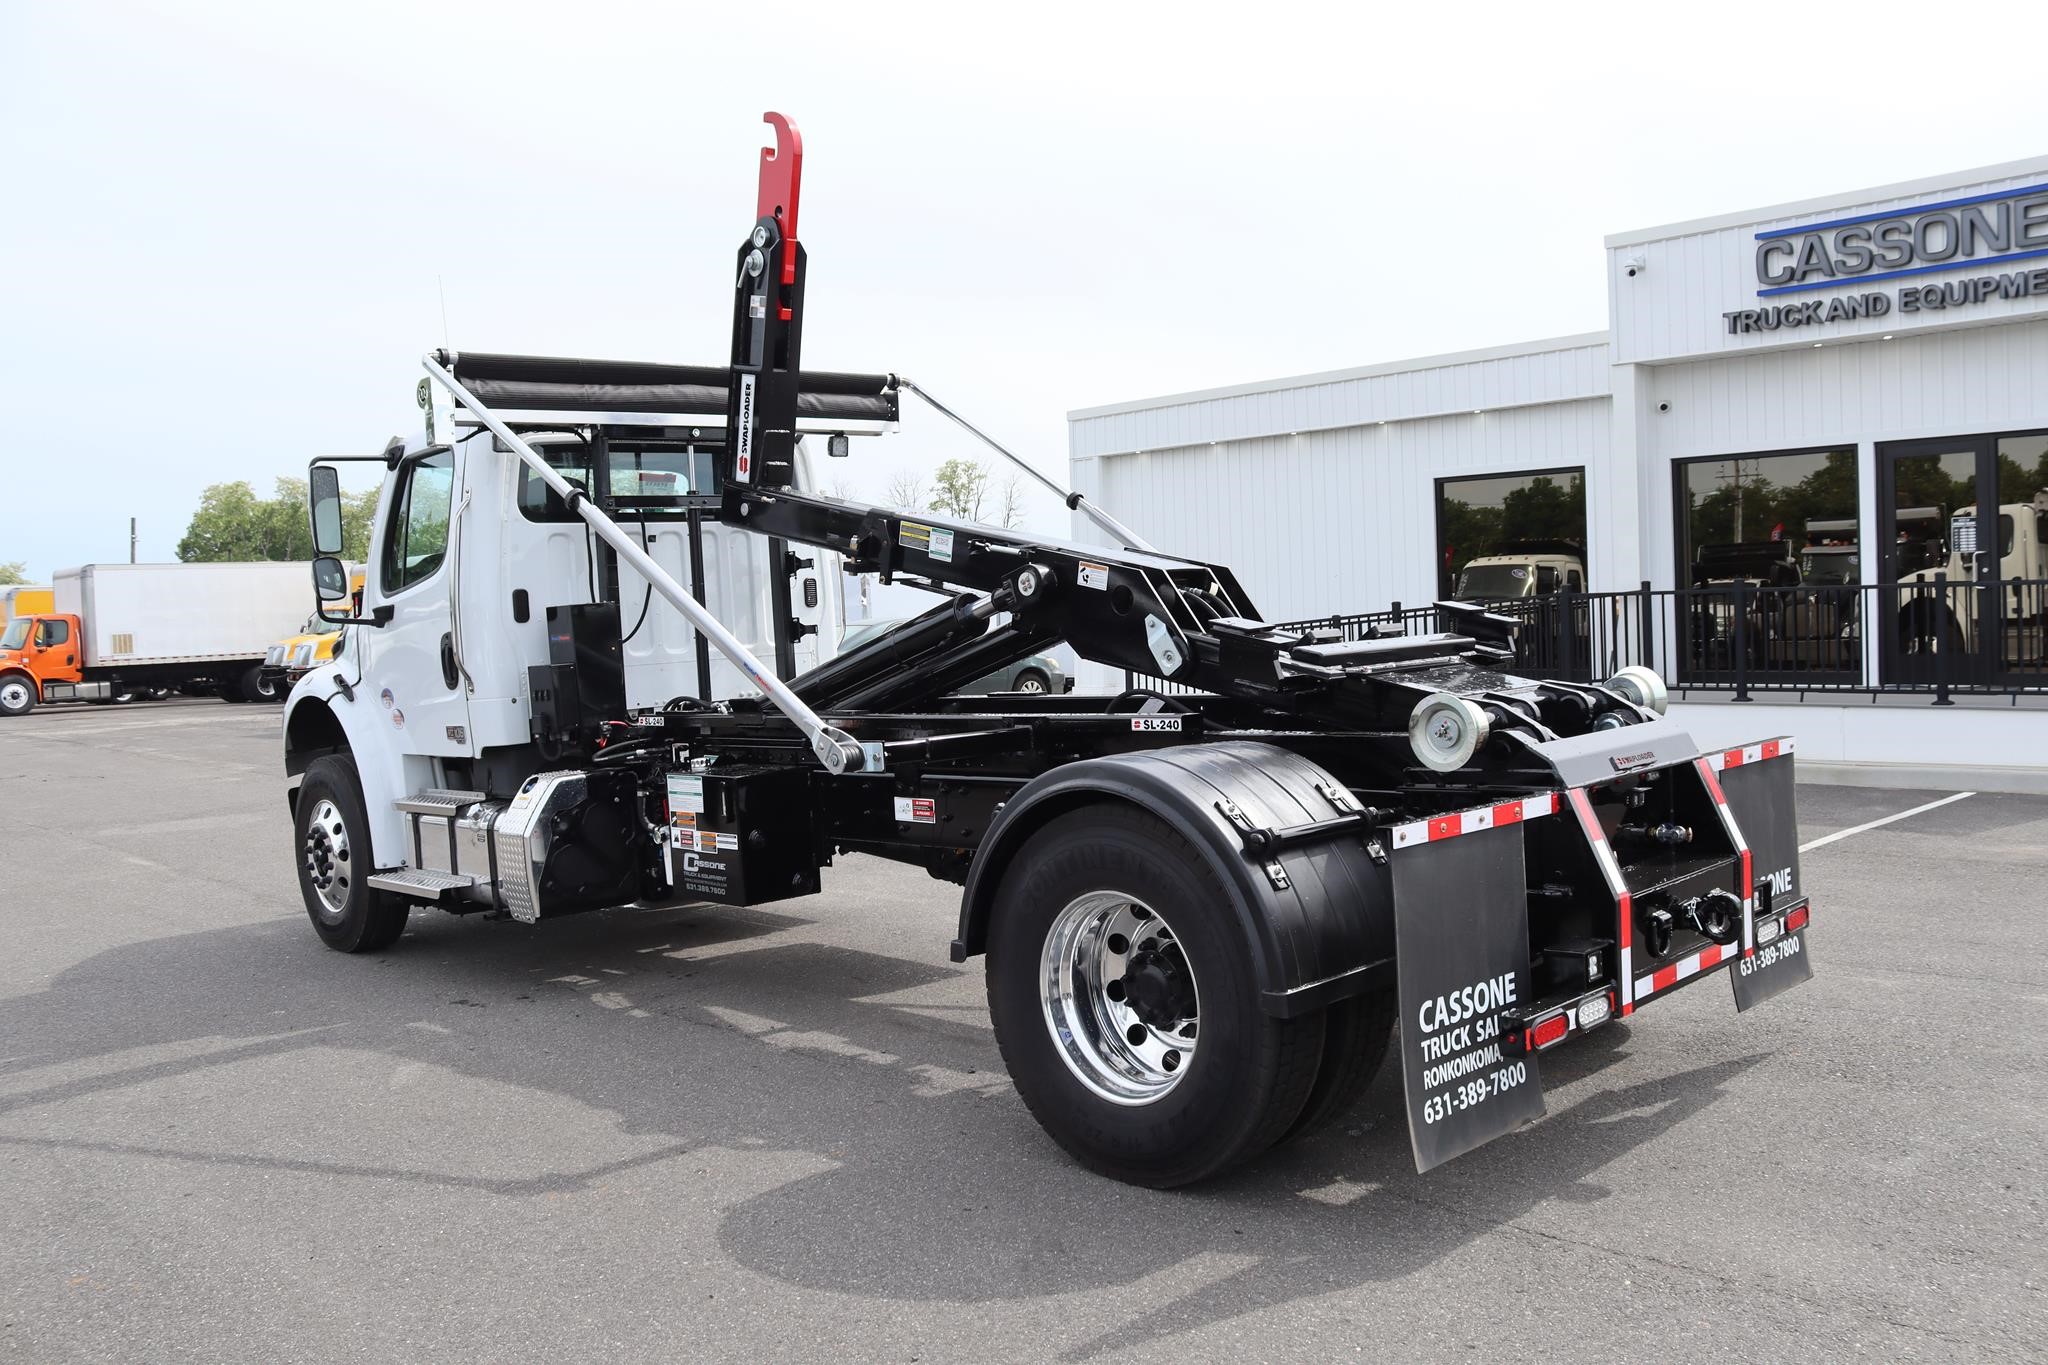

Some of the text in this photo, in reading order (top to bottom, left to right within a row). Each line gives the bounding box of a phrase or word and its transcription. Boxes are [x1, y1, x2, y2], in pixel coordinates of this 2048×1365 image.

[1755, 195, 2048, 286] CASSONE
[1723, 299, 1825, 335] TRUCK
[1825, 292, 1891, 324] AND
[741, 383, 751, 454] SWAPLOADER
[1143, 719, 1180, 730] SL-240
[683, 852, 726, 872] CASSONE
[1740, 936, 1800, 977] 631-389-7800
[1419, 972, 1517, 1033] CASSONE
[1421, 1024, 1472, 1063] TRUCK
[1423, 1043, 1504, 1090] RONKONKOMA,
[1424, 1062, 1527, 1124] 631-389-7800
